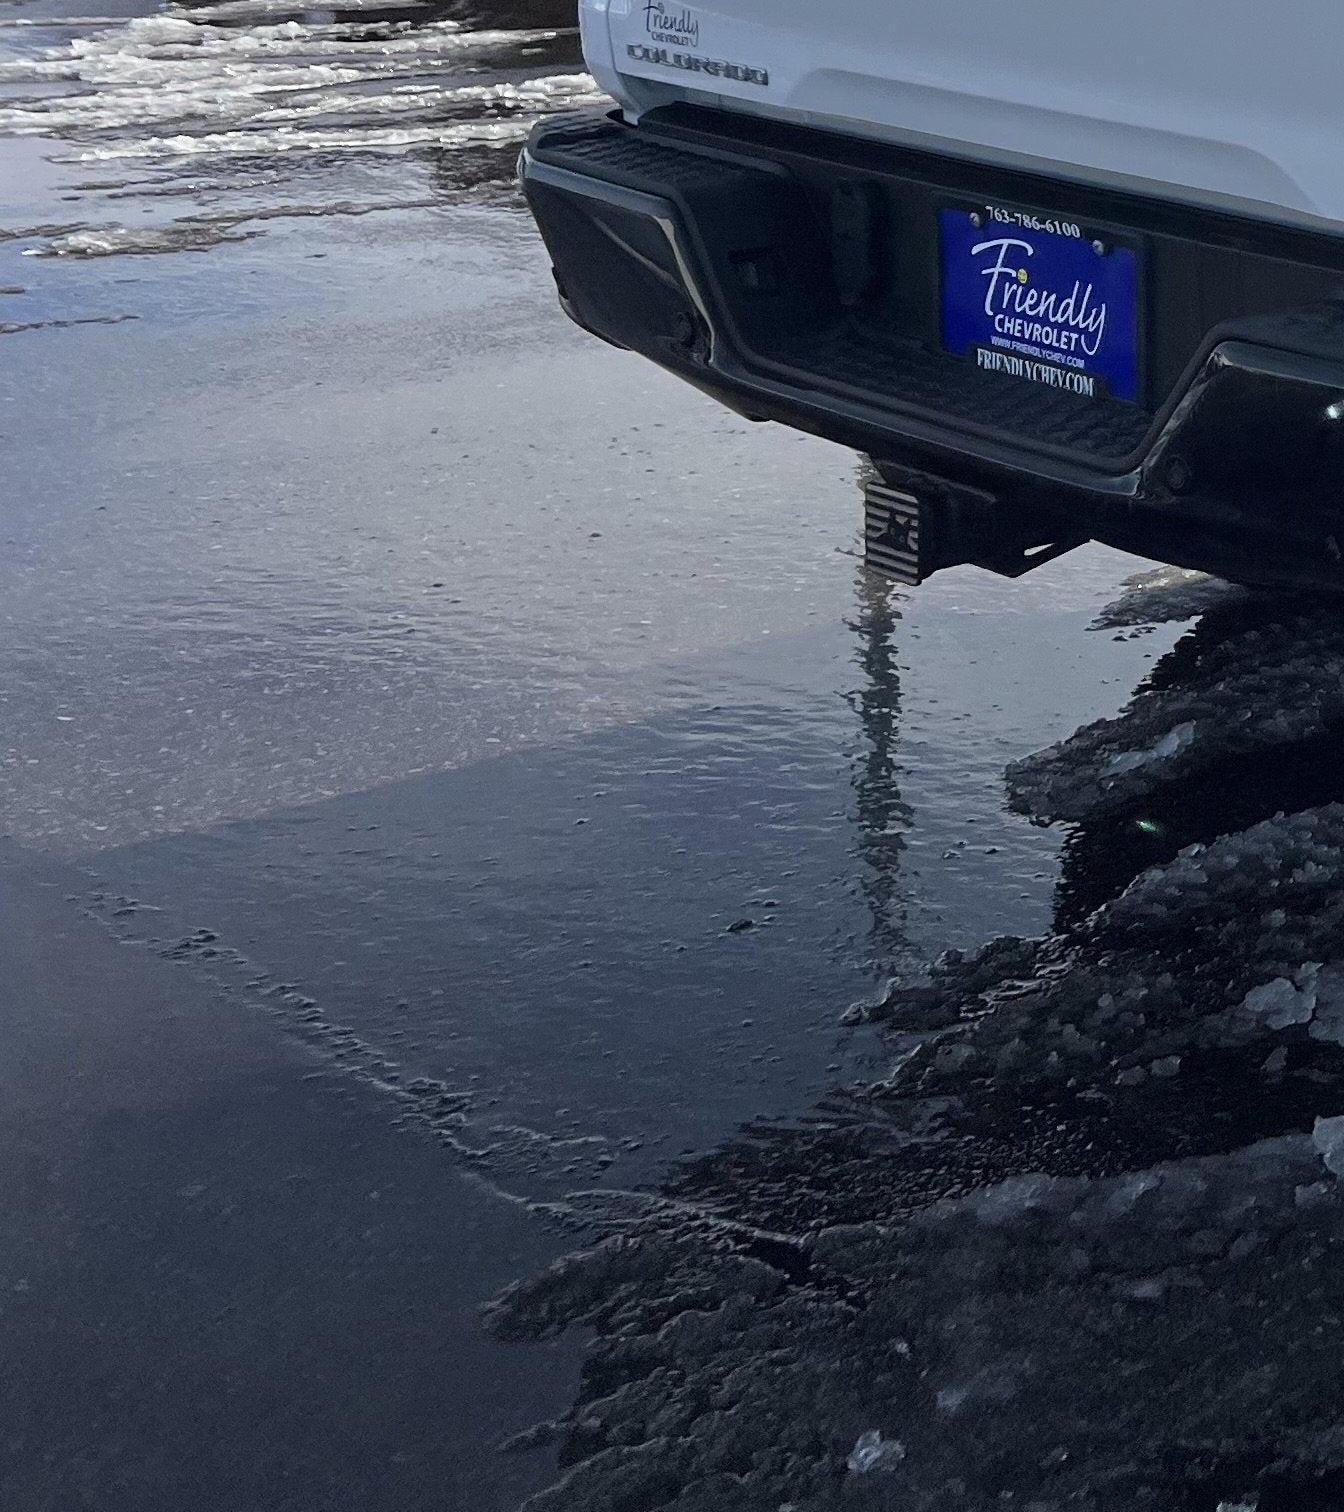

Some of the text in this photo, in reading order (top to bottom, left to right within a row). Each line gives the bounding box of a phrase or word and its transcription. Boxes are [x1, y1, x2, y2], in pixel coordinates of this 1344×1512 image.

[985, 205, 1081, 238] 763-786-6100
[971, 238, 1106, 355] Friendly
[994, 314, 1080, 351] CHEVROLET
[990, 335, 1086, 369] WWW.FRIENDLYCHEV.COM
[976, 348, 1095, 397] FRIENDLYCHEV.COM
